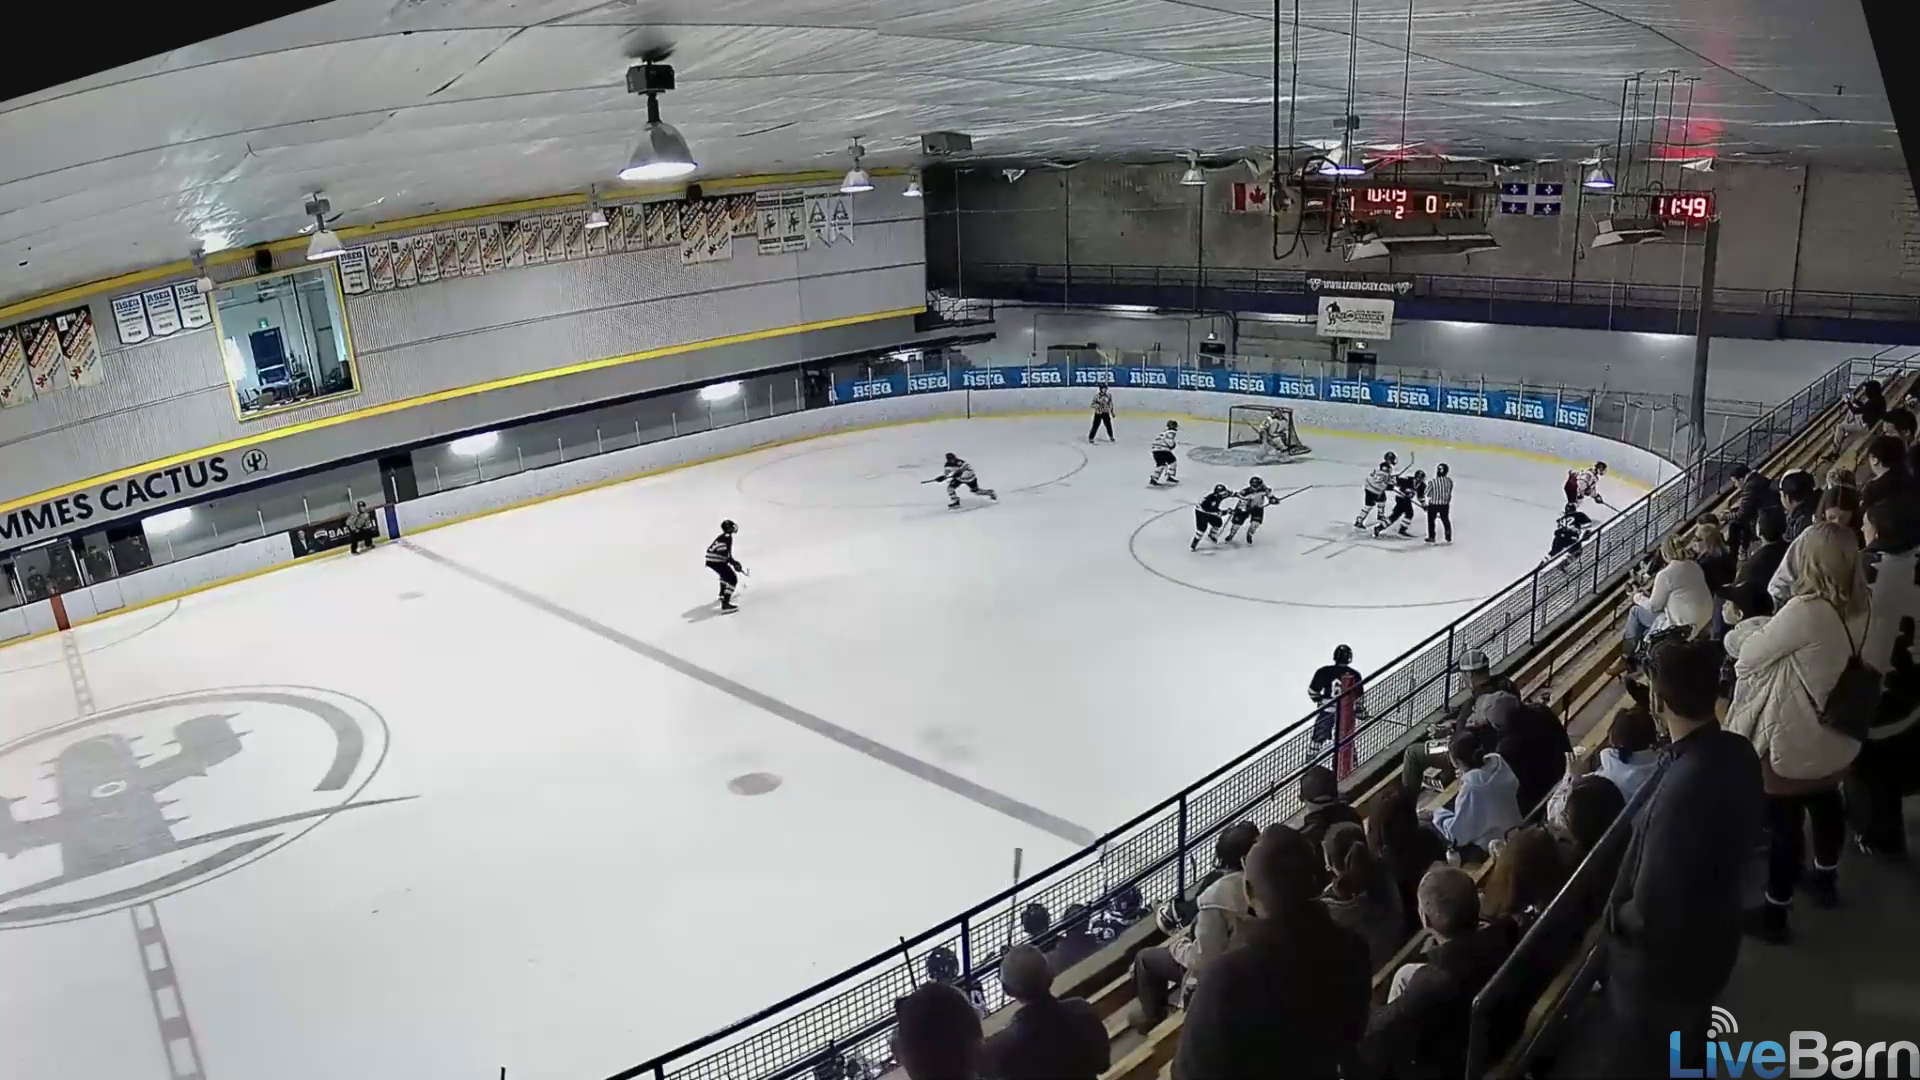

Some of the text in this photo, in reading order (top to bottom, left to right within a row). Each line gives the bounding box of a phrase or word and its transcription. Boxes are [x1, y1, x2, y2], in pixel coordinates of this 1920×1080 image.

[1394, 205, 1405, 220] 2
[1425, 195, 1438, 214] 0
[1659, 197, 1706, 218] 11:49
[100, 456, 229, 512] CACTUS
